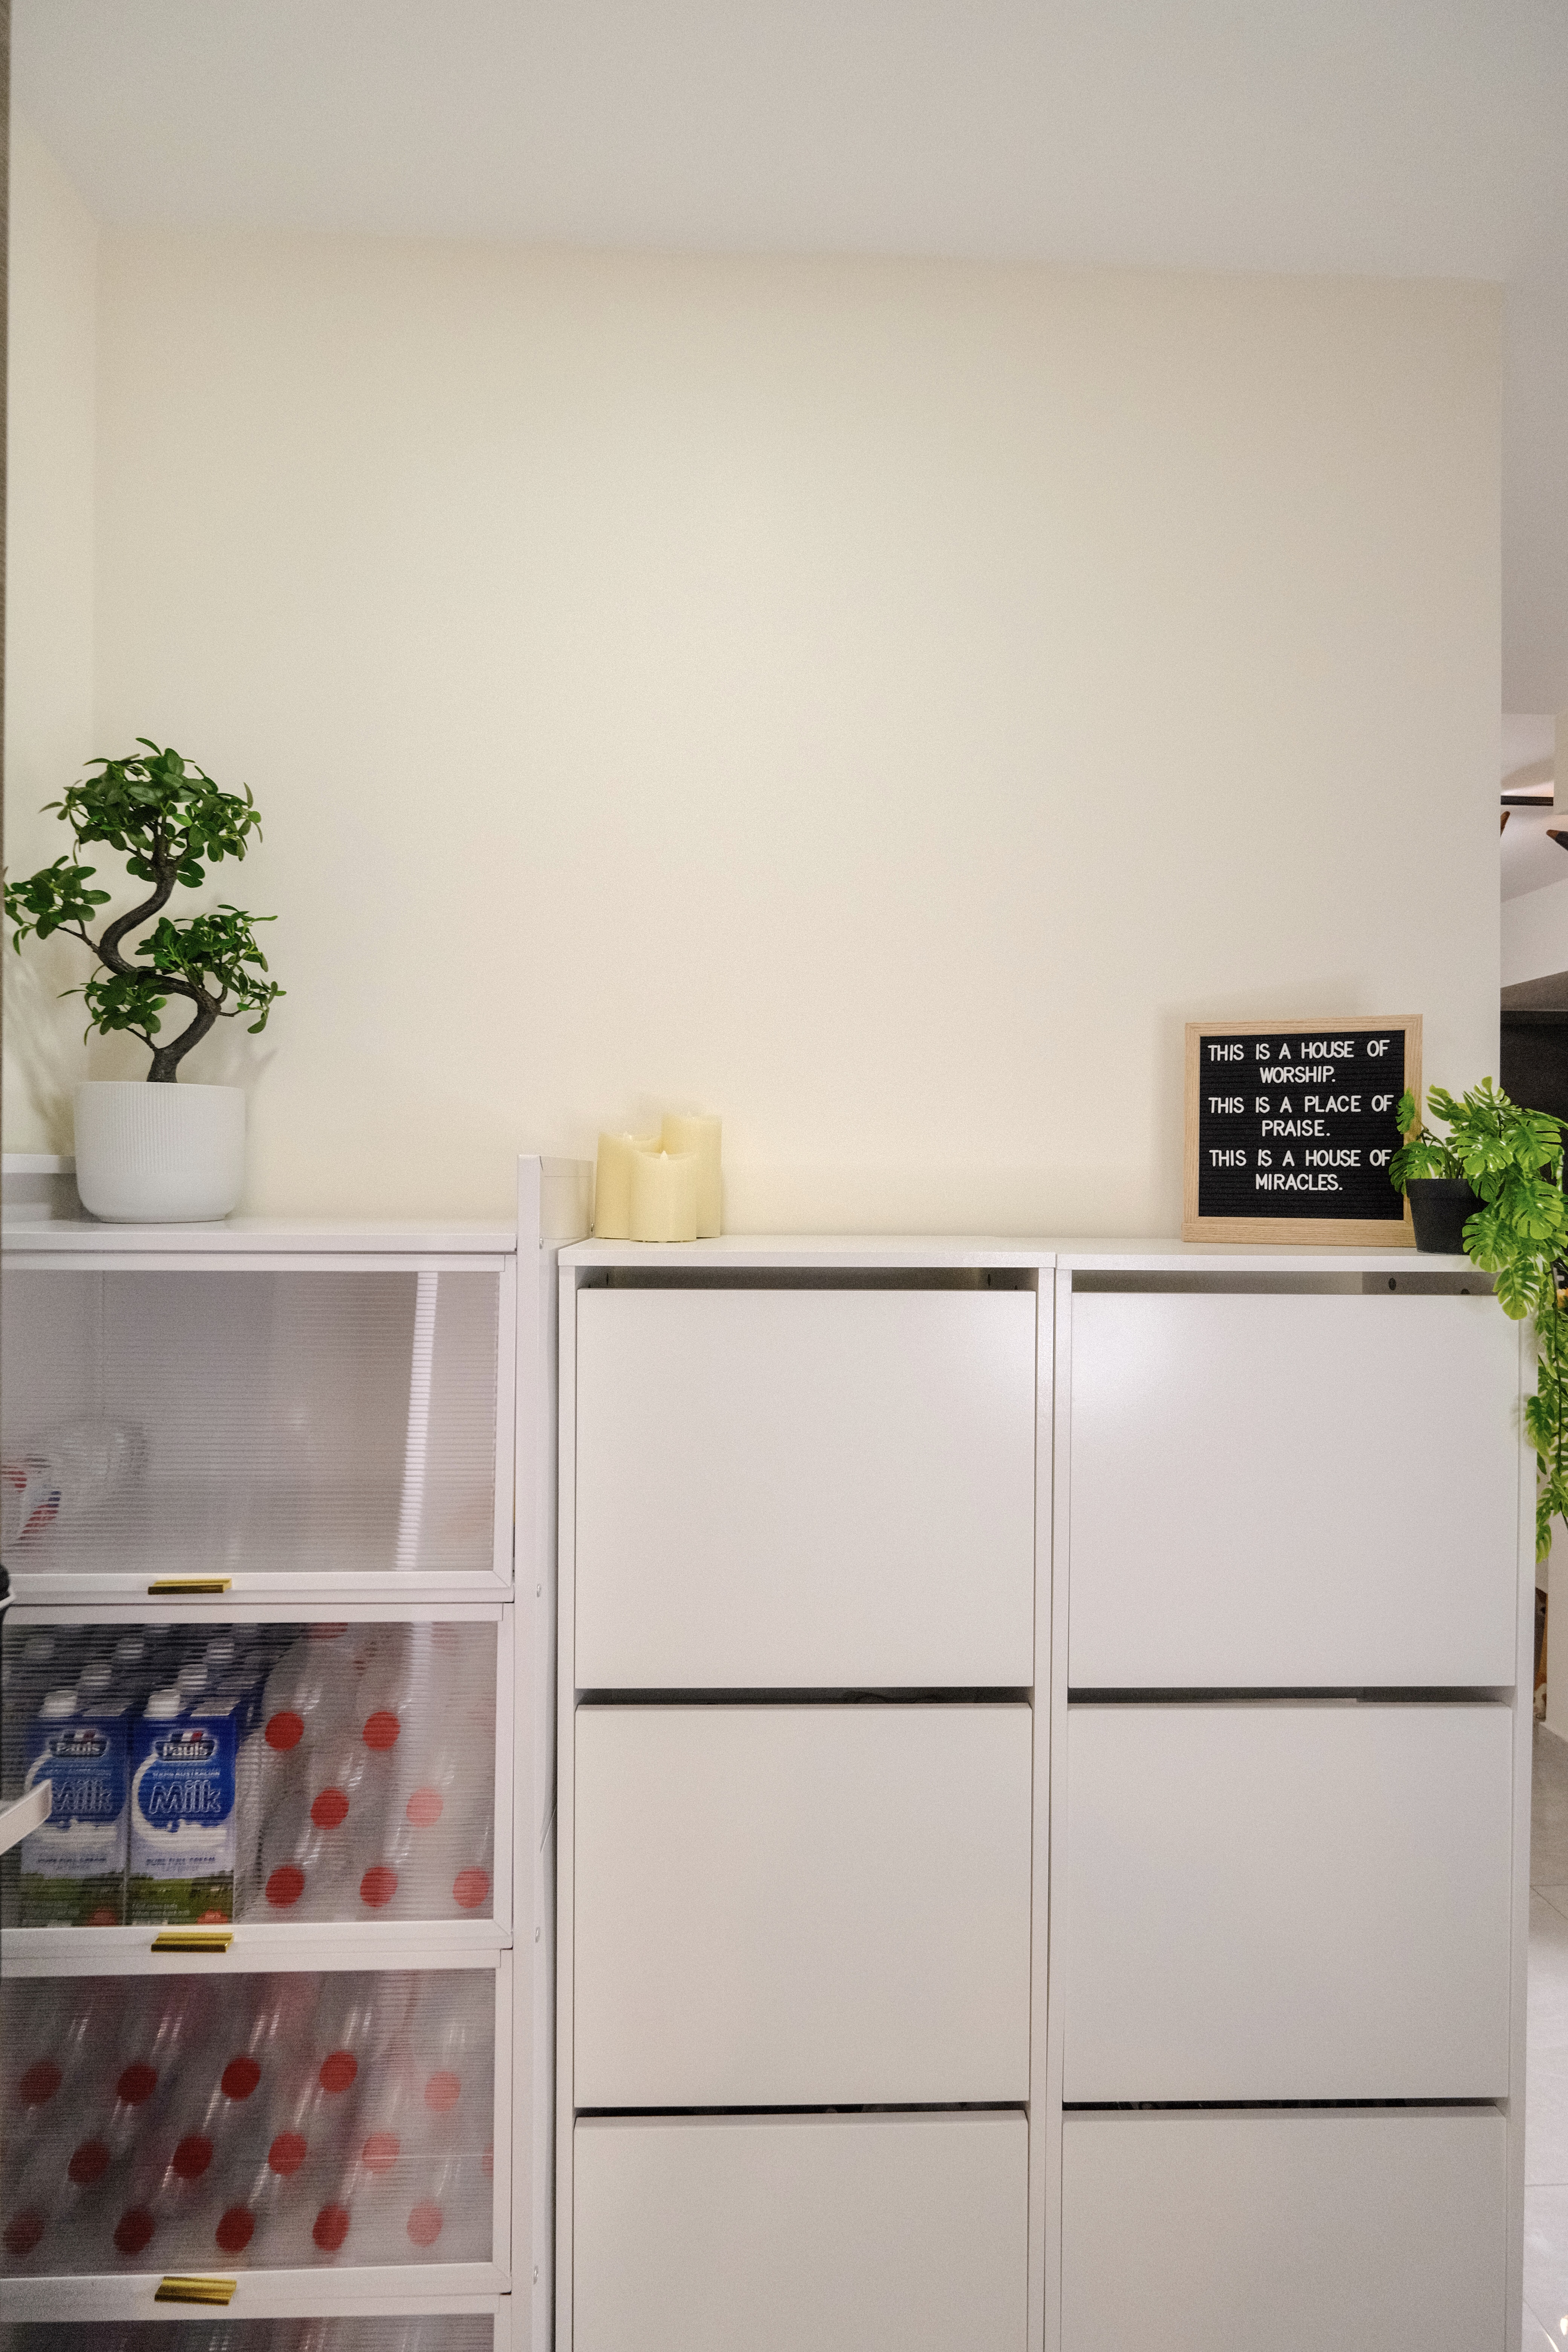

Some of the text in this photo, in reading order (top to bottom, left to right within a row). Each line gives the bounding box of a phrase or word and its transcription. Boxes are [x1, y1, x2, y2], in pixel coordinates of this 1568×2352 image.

[1207, 1040, 1390, 1061] THIS IS A HOUSE OF
[1259, 1066, 1336, 1083] WORSHIP.
[1208, 1095, 1394, 1114] THIS IS A PLACE OF
[1262, 1119, 1330, 1137] PRAISE.
[1209, 1149, 1392, 1167] THIS IS A HOUSE OF
[1256, 1173, 1343, 1191] MIRACLES.
[57, 1741, 101, 1755] Pauls
[163, 1742, 208, 1757] Pauls
[149, 1779, 222, 1815] Milk
